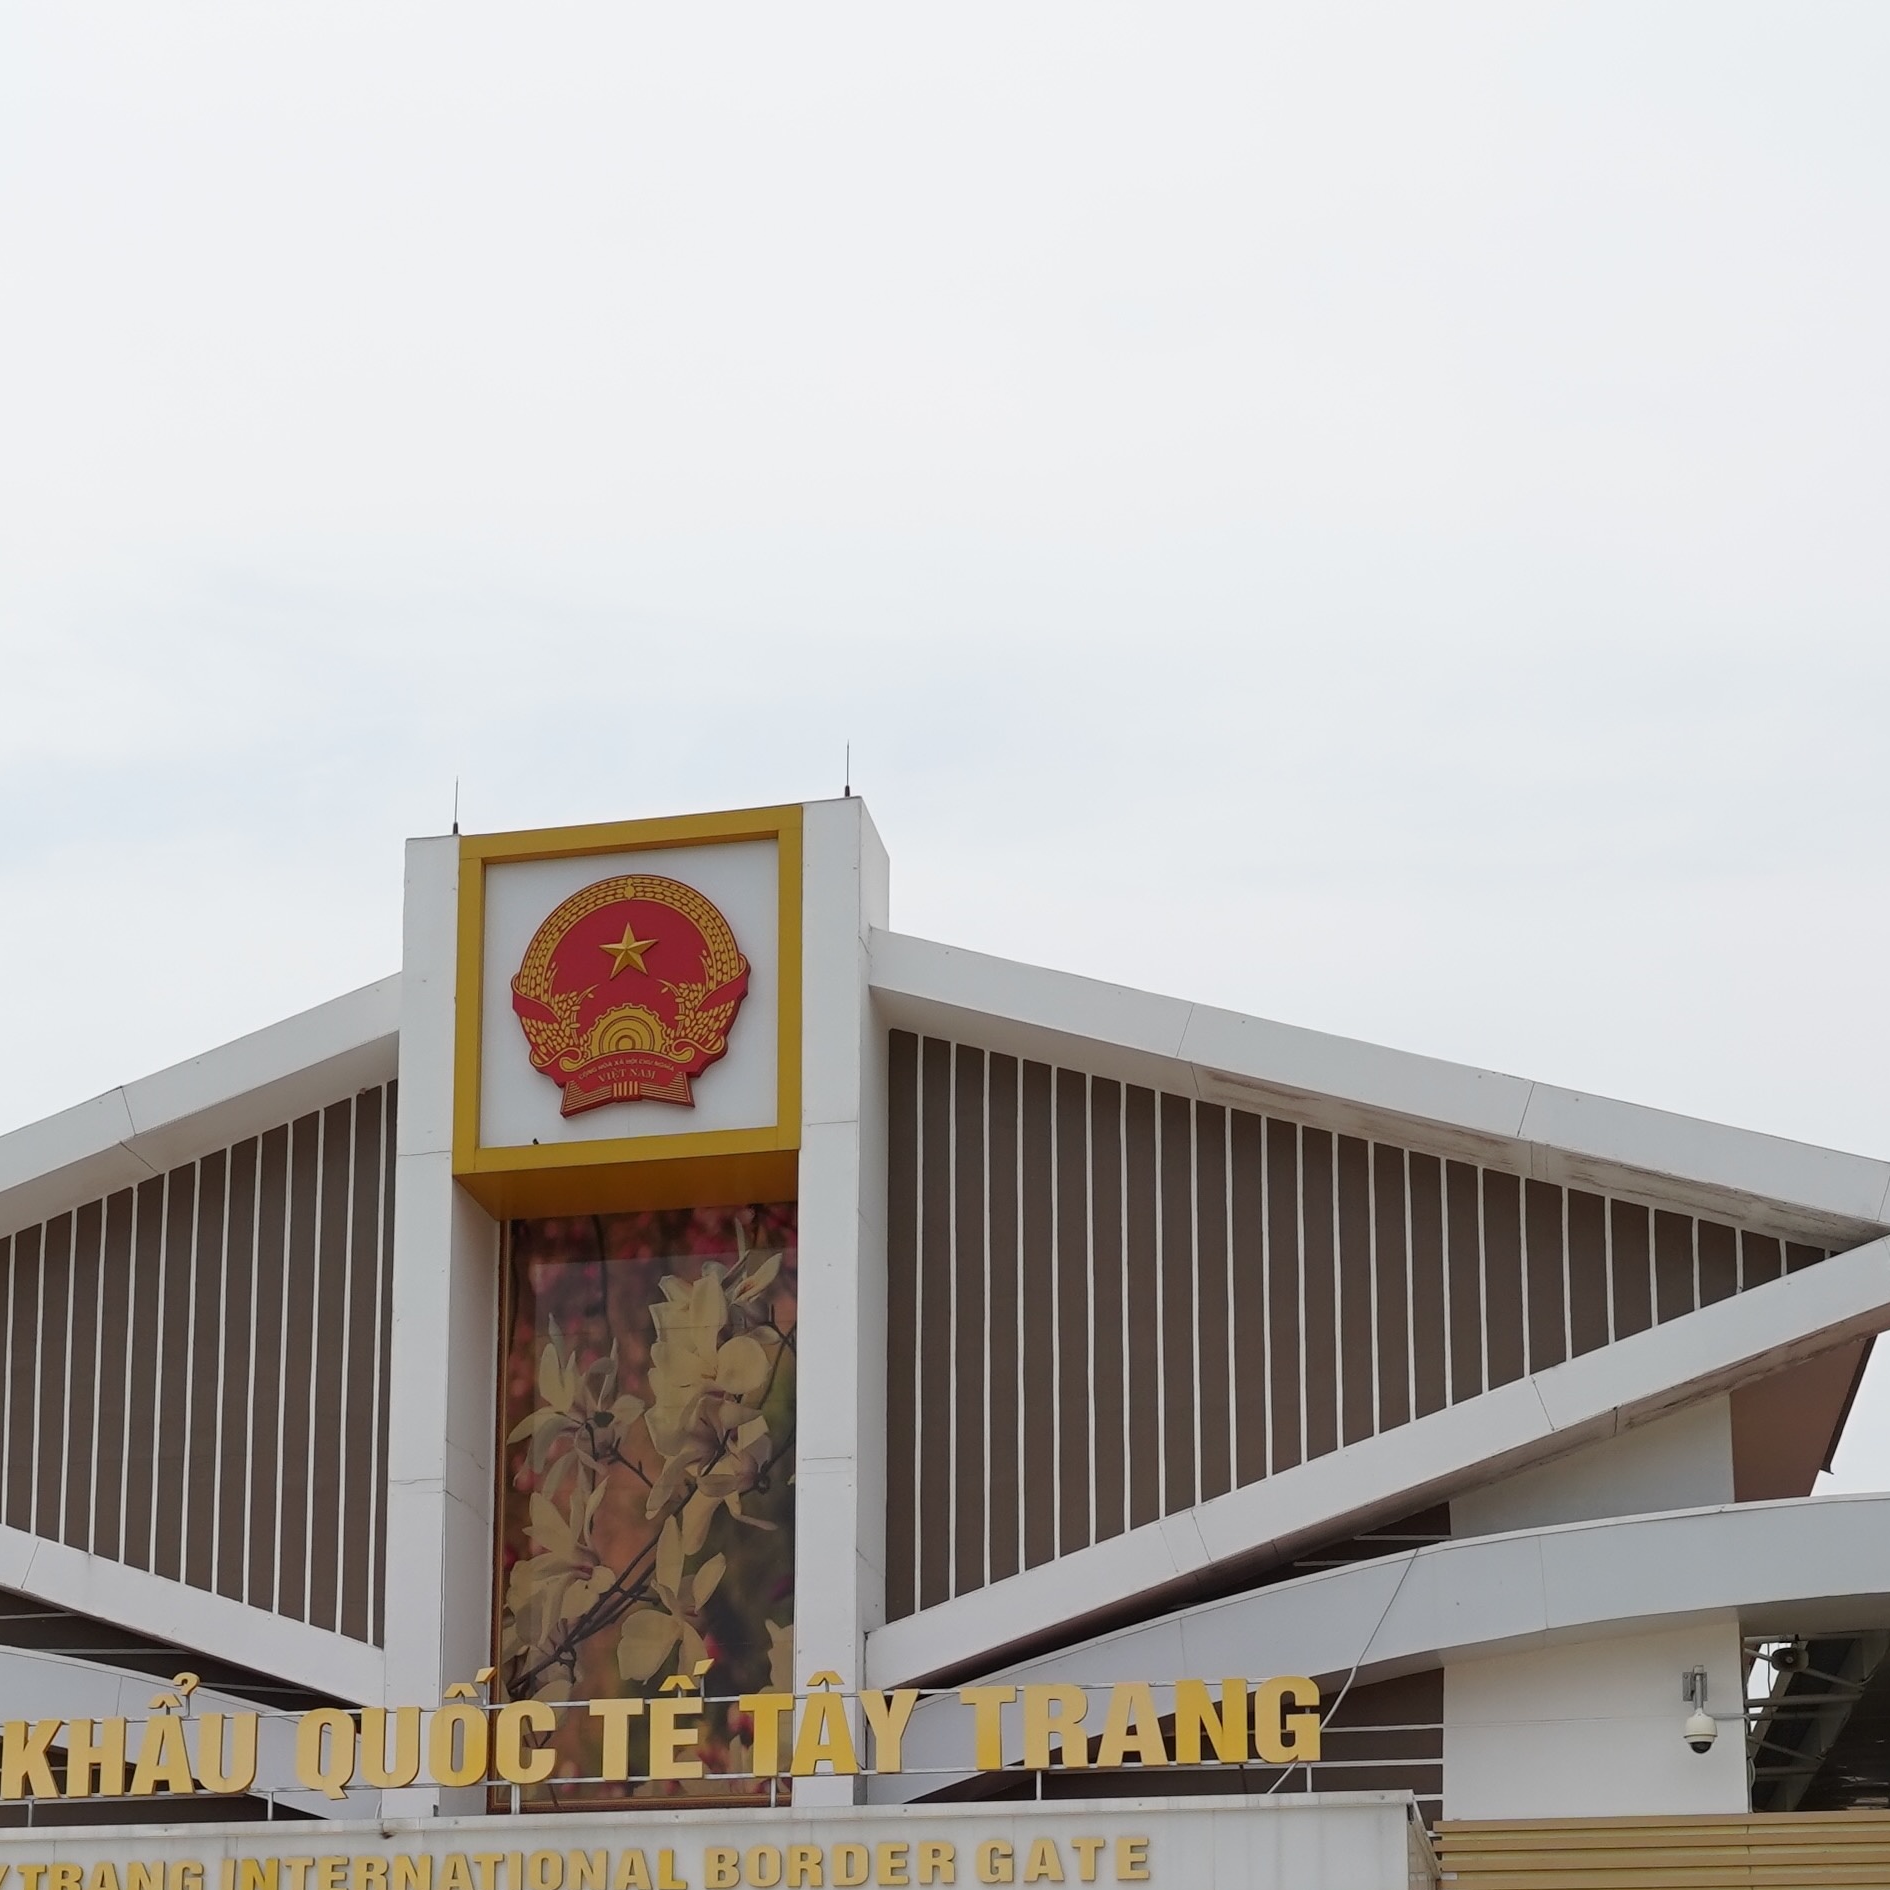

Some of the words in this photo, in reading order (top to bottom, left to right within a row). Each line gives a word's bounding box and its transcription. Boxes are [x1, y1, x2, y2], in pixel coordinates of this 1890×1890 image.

[1, 1672, 257, 1798] KHẨU
[295, 1667, 560, 1800] QUỐC
[589, 1658, 714, 1781] TẾ
[739, 1671, 919, 1778] TÂY
[960, 1675, 1321, 1771] TRANG
[704, 1841, 956, 1889] BORDER
[977, 1836, 1151, 1883] GATE
